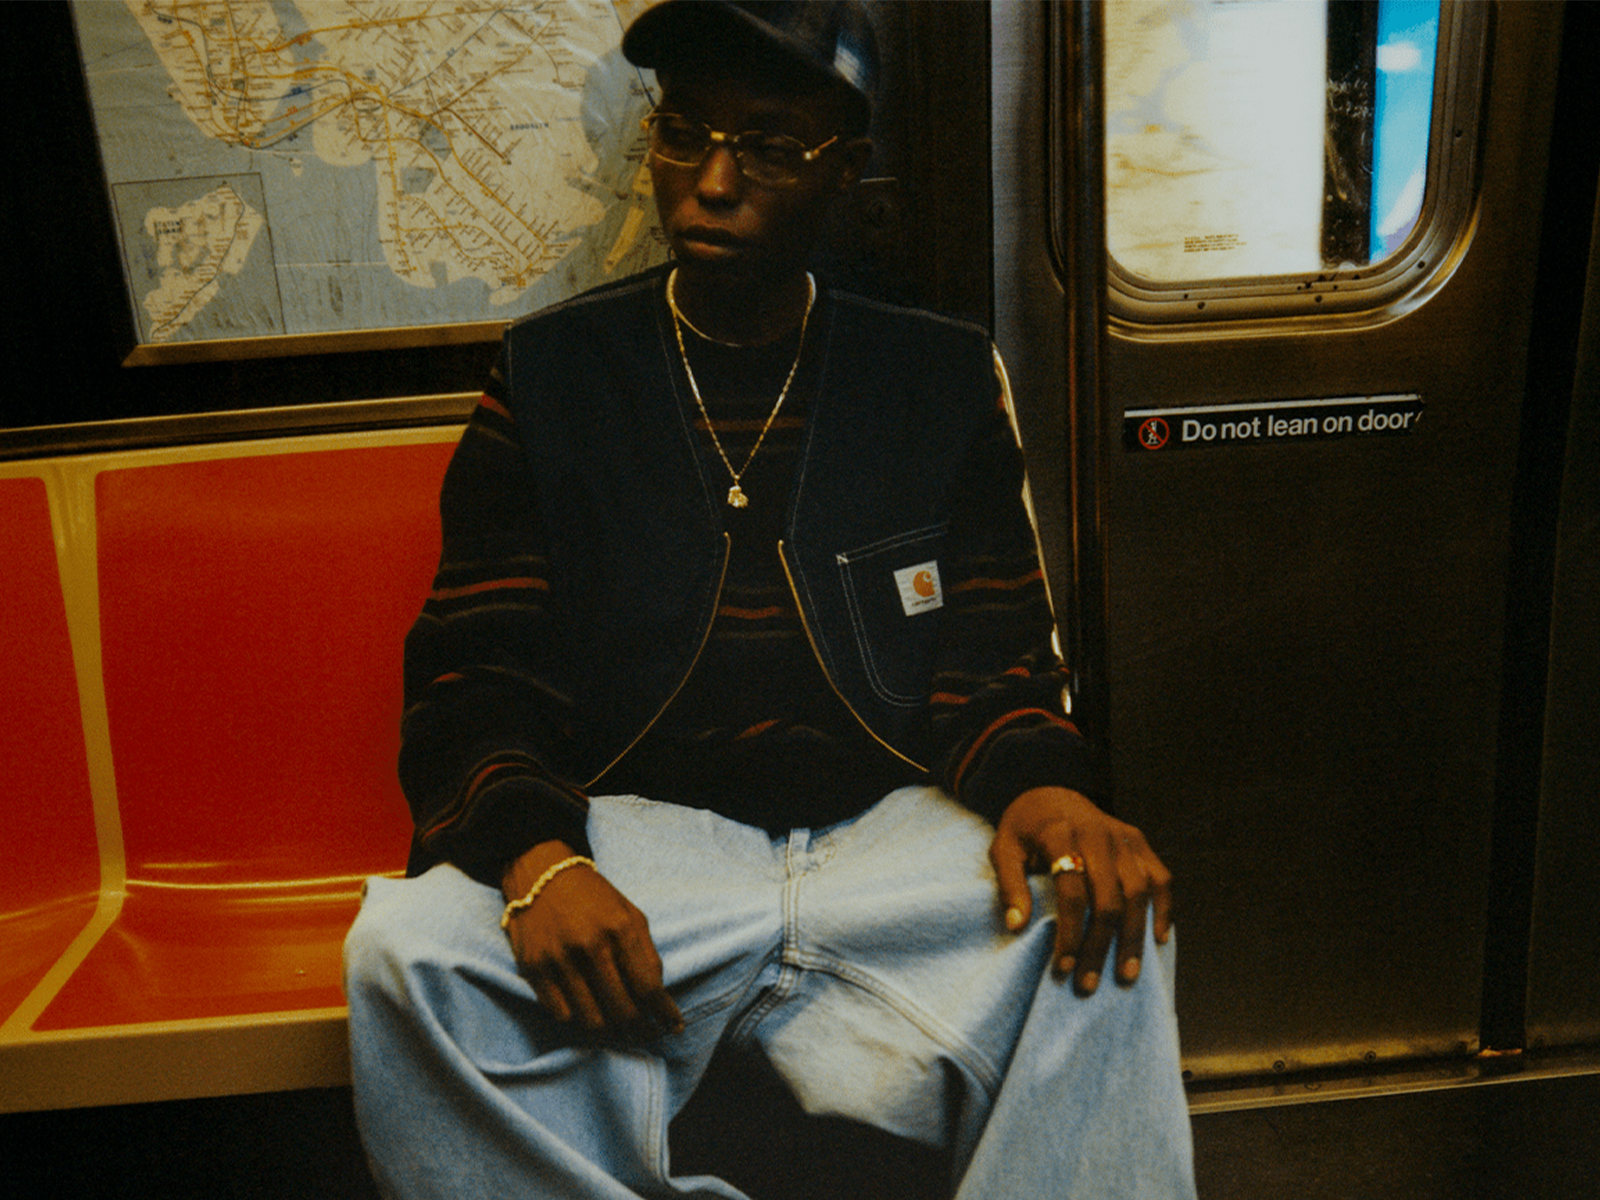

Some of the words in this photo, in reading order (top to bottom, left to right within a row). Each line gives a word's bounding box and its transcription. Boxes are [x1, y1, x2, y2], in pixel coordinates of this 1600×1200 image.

[1182, 419, 1217, 442] Do
[1222, 417, 1261, 439] not
[1267, 415, 1317, 437] lean
[1323, 414, 1352, 432] on
[1358, 409, 1413, 431] door
